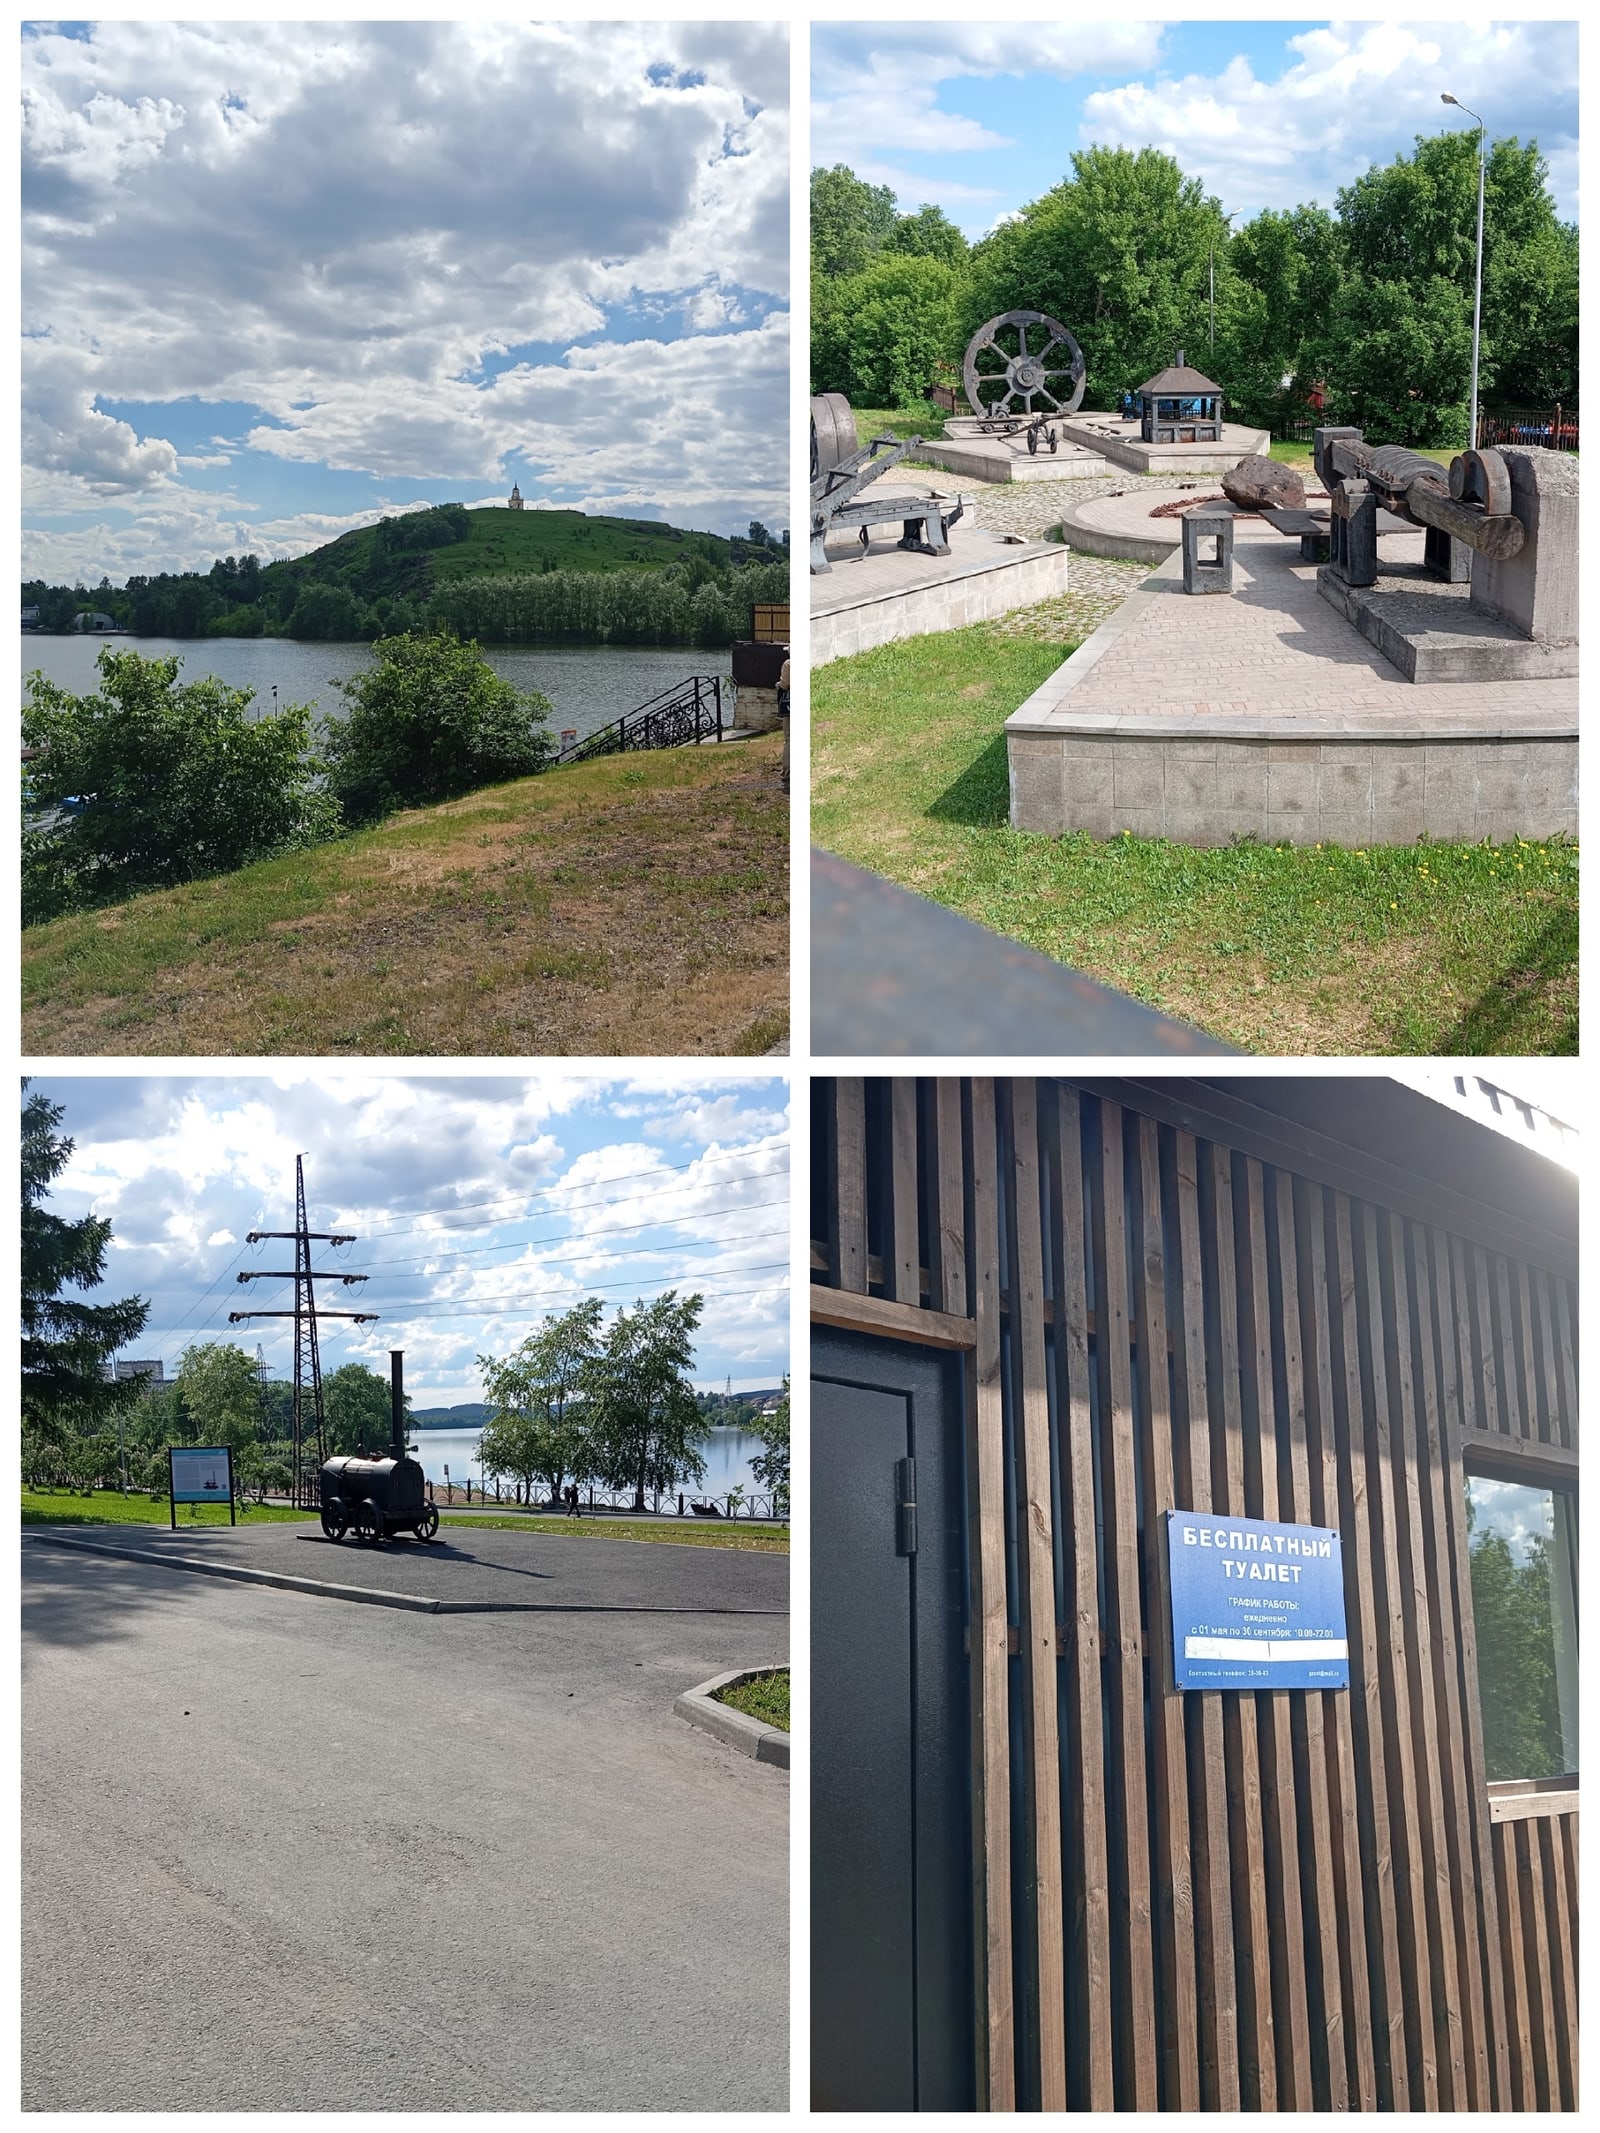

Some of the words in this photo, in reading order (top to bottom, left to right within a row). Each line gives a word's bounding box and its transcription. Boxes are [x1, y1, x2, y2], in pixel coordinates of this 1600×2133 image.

[1183, 1527, 1331, 1558] БЕСПЛАТНЫЙ
[1222, 1560, 1303, 1584] ТУАЛЕТ
[1228, 1597, 1261, 1608] ГРАФИК
[1263, 1599, 1300, 1610] РАБОТЫ:
[1243, 1614, 1288, 1624] ежедневно
[1199, 1625, 1209, 1635] 01
[1211, 1627, 1228, 1636] мая
[1229, 1627, 1240, 1636] по
[1242, 1626, 1252, 1636] 30
